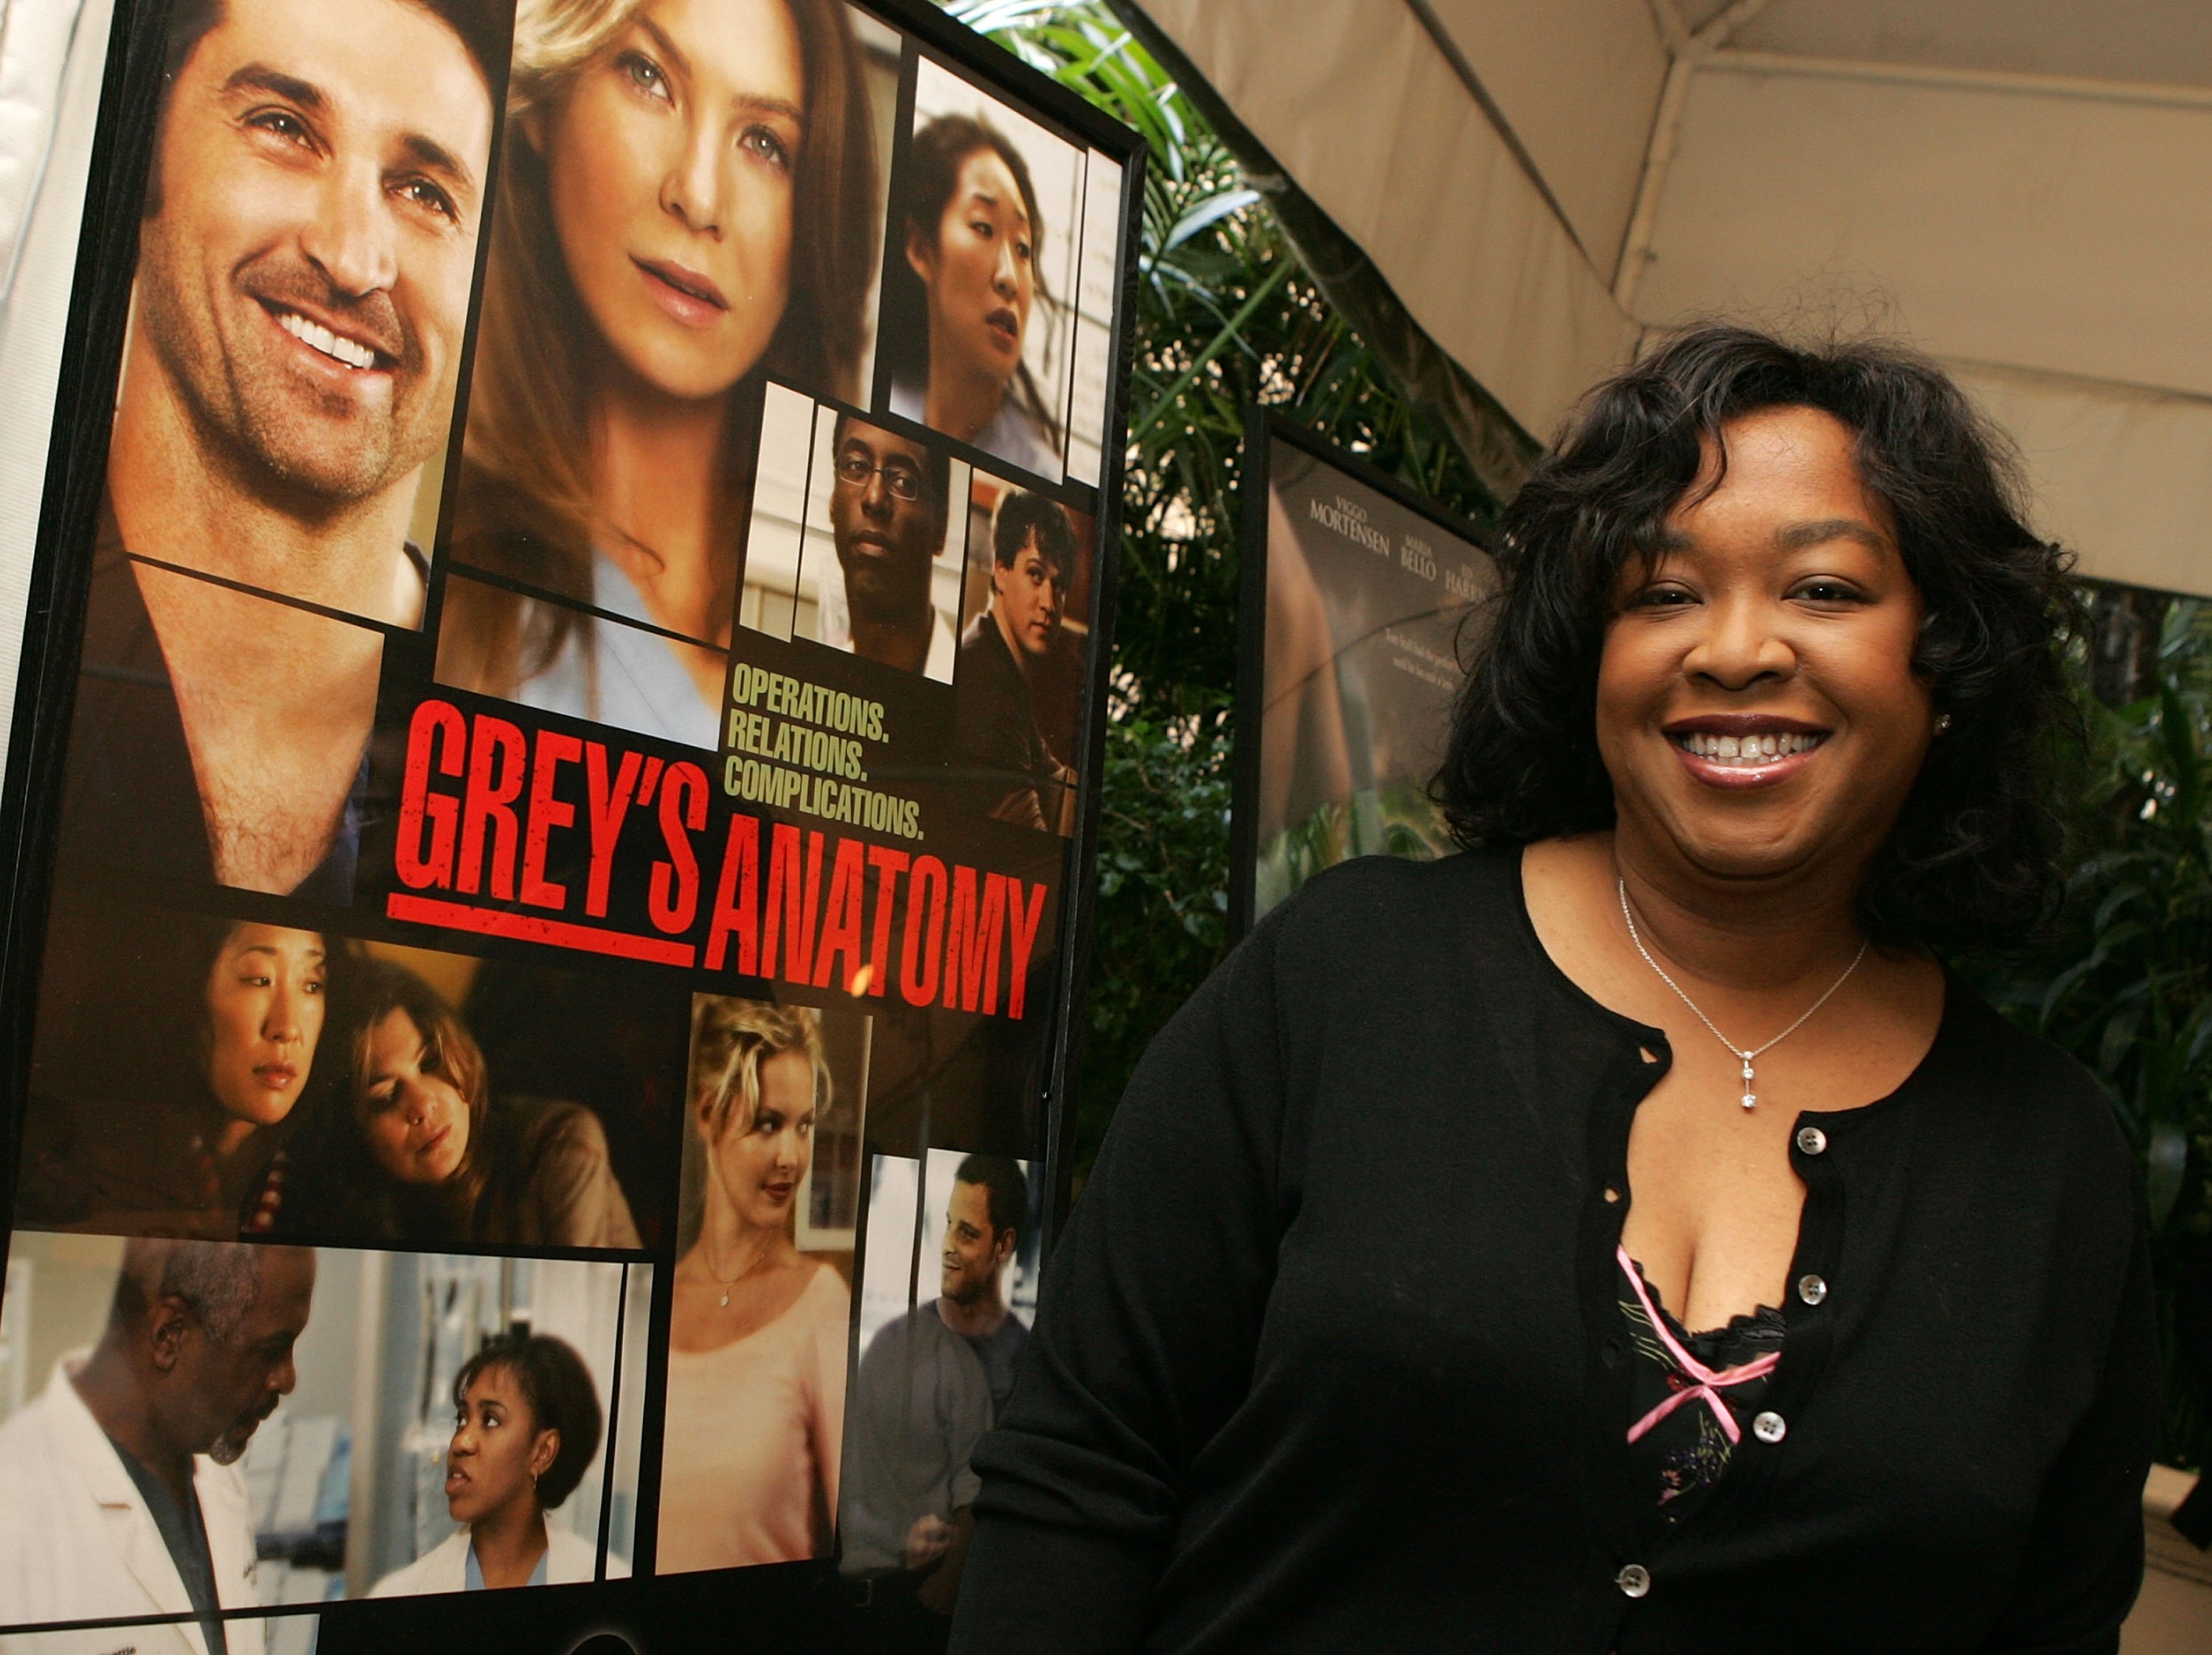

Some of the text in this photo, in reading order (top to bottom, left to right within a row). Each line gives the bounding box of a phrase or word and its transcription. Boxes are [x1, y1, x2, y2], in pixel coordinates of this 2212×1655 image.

[1310, 499, 1390, 557] MORTENSEN
[1401, 547, 1436, 581] BELLO
[733, 663, 889, 743] OPERATIONS.
[728, 708, 867, 781] RELATIONS.
[723, 755, 925, 840] COMPLICATIONS.
[395, 700, 1046, 1020] GREY'S ANATOMY
